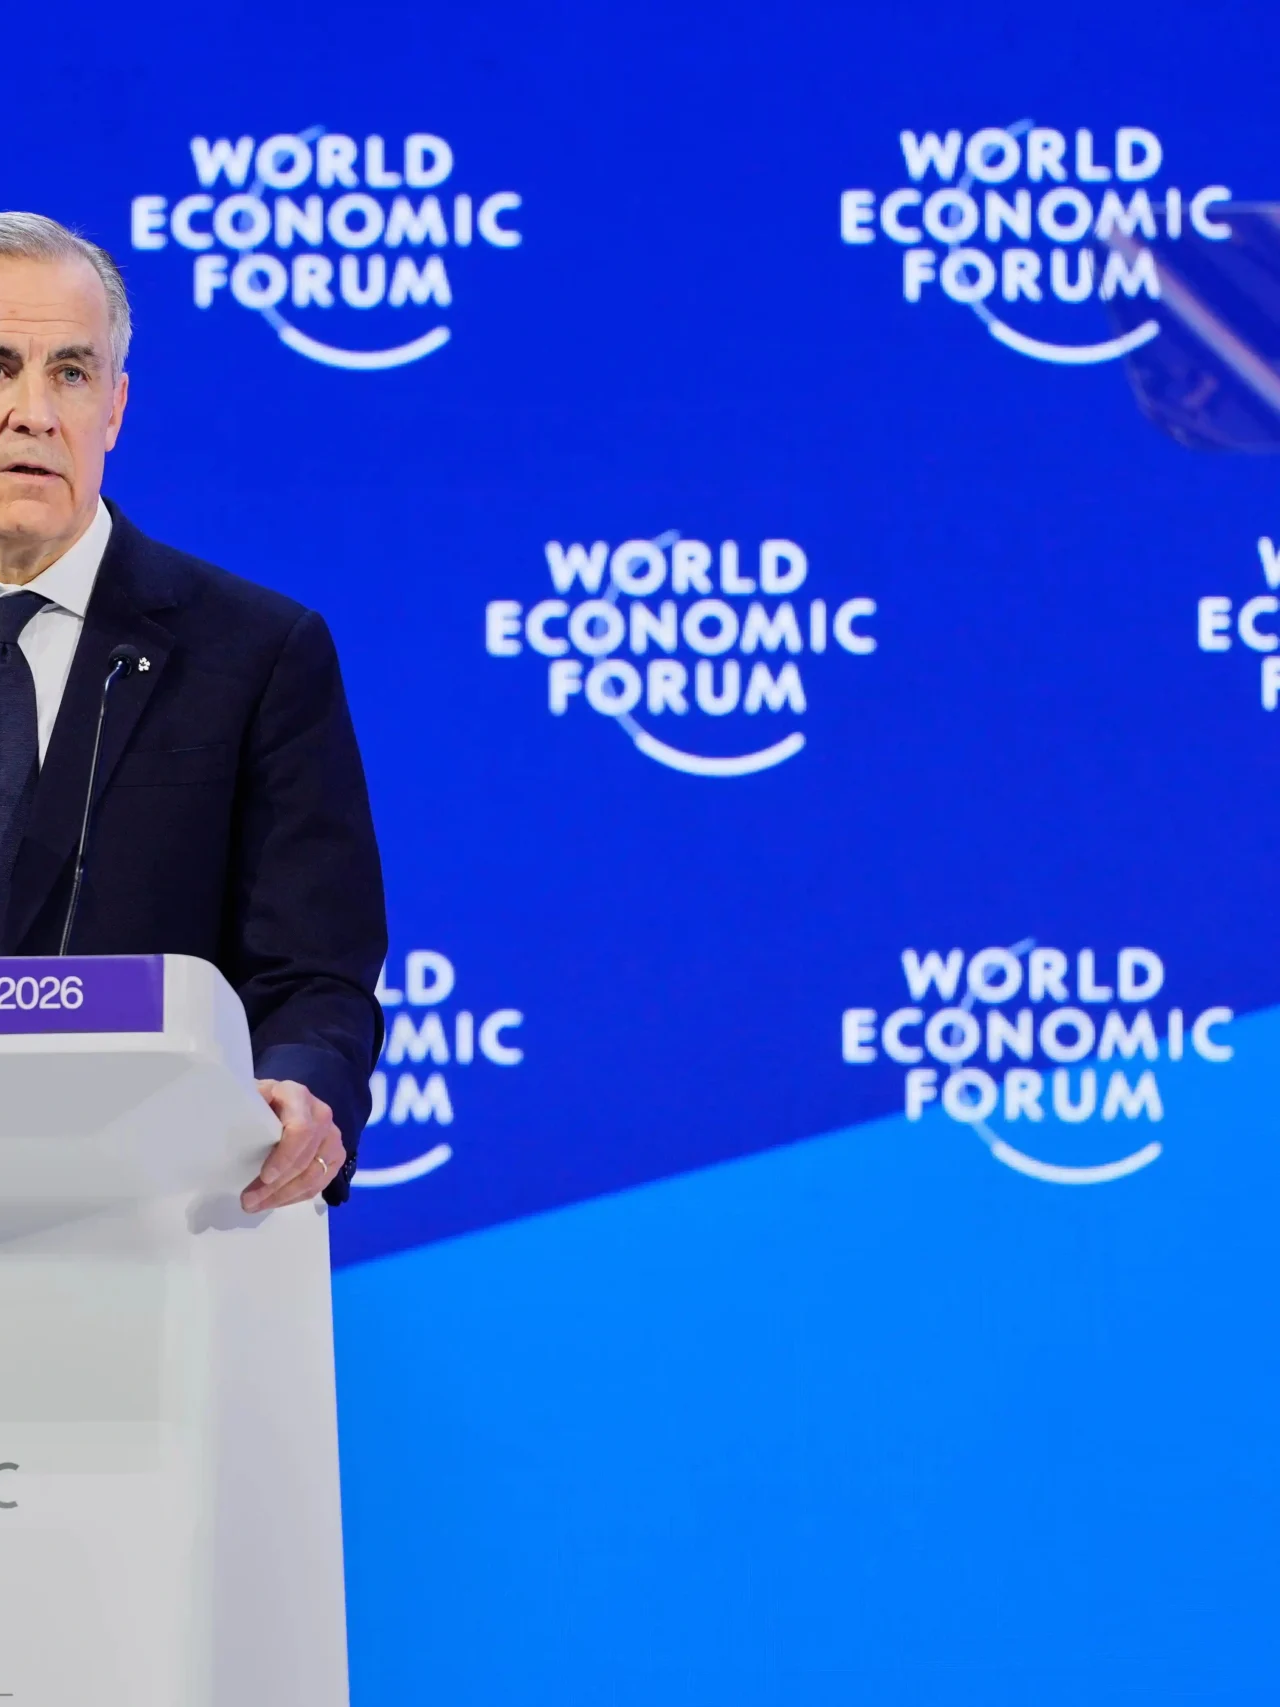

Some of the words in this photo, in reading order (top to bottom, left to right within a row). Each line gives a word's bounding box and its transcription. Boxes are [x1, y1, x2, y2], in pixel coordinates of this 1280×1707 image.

[192, 133, 454, 189] WORLD
[900, 127, 1164, 183] WORLD
[132, 192, 519, 249] ECONOMIC
[841, 185, 1230, 244] ECONOMIC
[195, 253, 452, 309] FORUM
[904, 247, 1162, 303] FORUM
[546, 538, 808, 596] WORLD
[486, 598, 875, 656] ECONOMIC
[549, 659, 807, 716] FORUM
[902, 947, 1166, 1003] WORLD
[842, 1007, 1232, 1062] ECONOMIC
[906, 1067, 1163, 1122] FORUM
